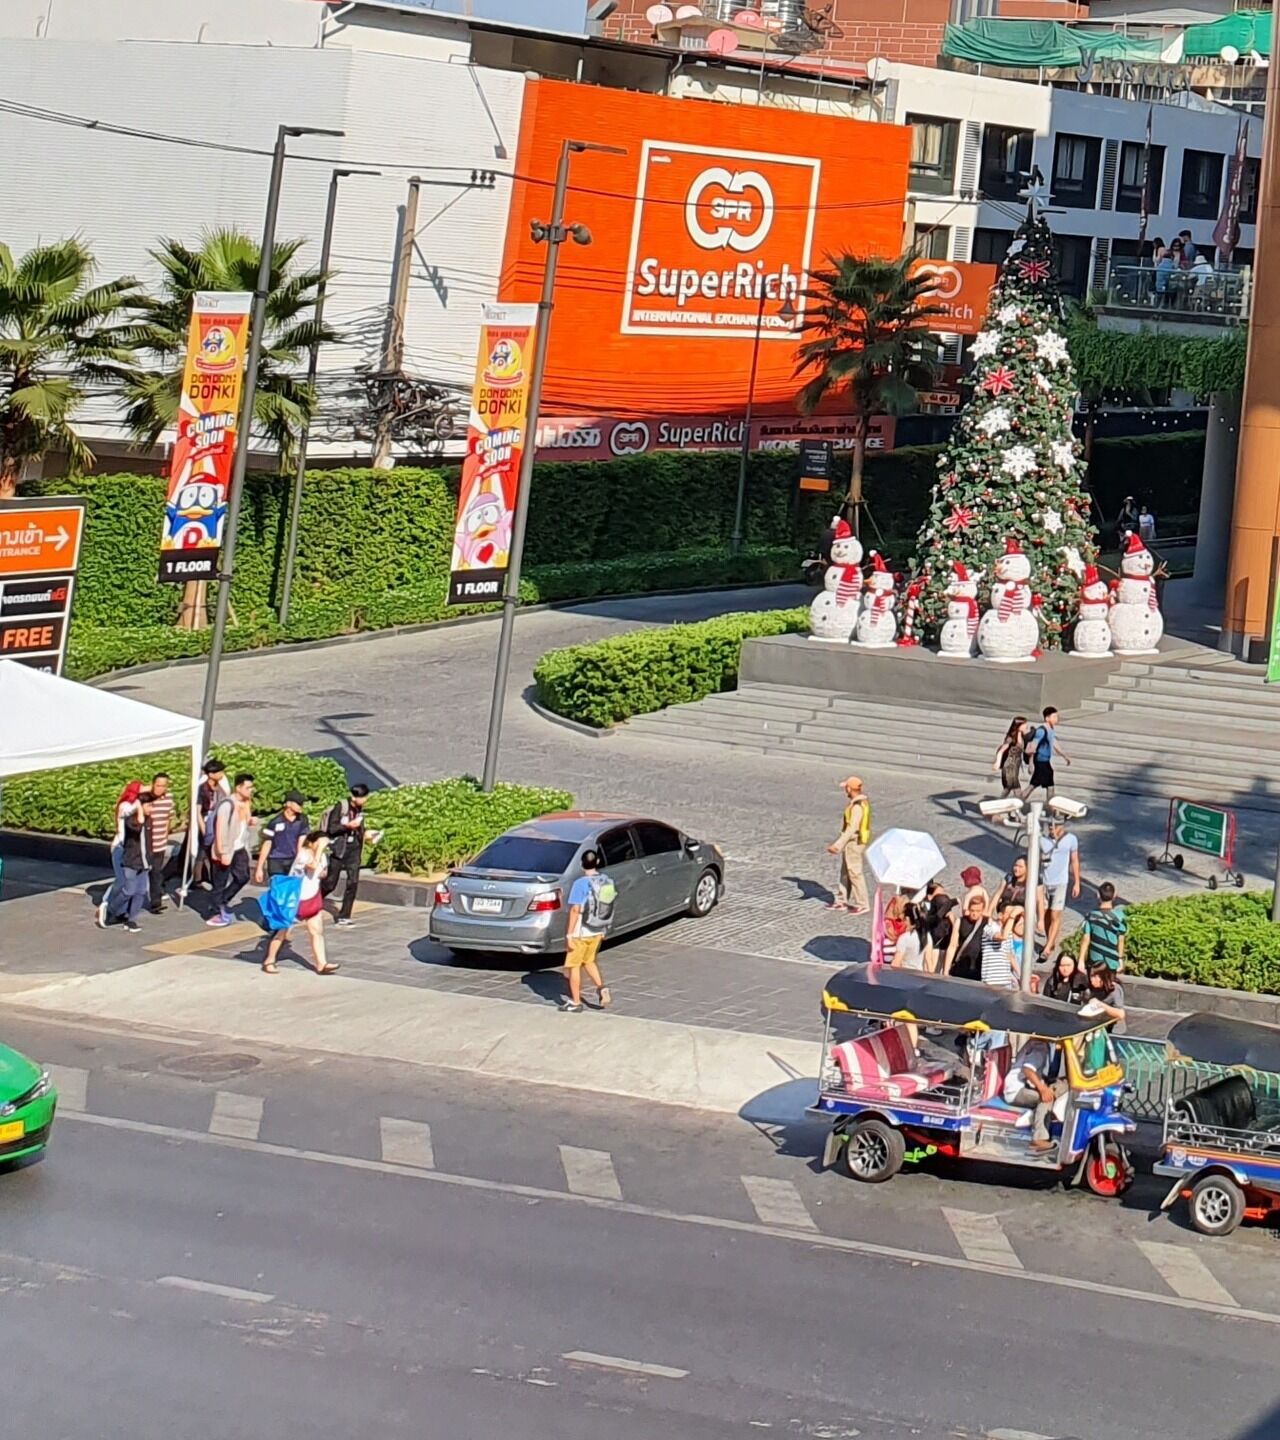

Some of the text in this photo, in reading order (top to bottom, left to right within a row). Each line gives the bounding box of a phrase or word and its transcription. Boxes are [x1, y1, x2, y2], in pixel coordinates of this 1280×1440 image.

[710, 197, 752, 222] SPR
[637, 257, 798, 307] SuperRich
[633, 309, 714, 325] INTERNATIONAL
[189, 384, 236, 399] DONKI
[478, 399, 522, 415] DONKI
[187, 413, 235, 438] COMING
[658, 421, 747, 447] SuperRich
[195, 430, 225, 449] SOON
[475, 430, 520, 454] COMING
[484, 446, 511, 466] SOON
[0, 522, 43, 545] างเข้า
[0, 546, 41, 558] NTRANCE
[175, 560, 211, 573] FLOOR
[464, 581, 498, 595] FLOOR
[3, 626, 53, 649] FREE
